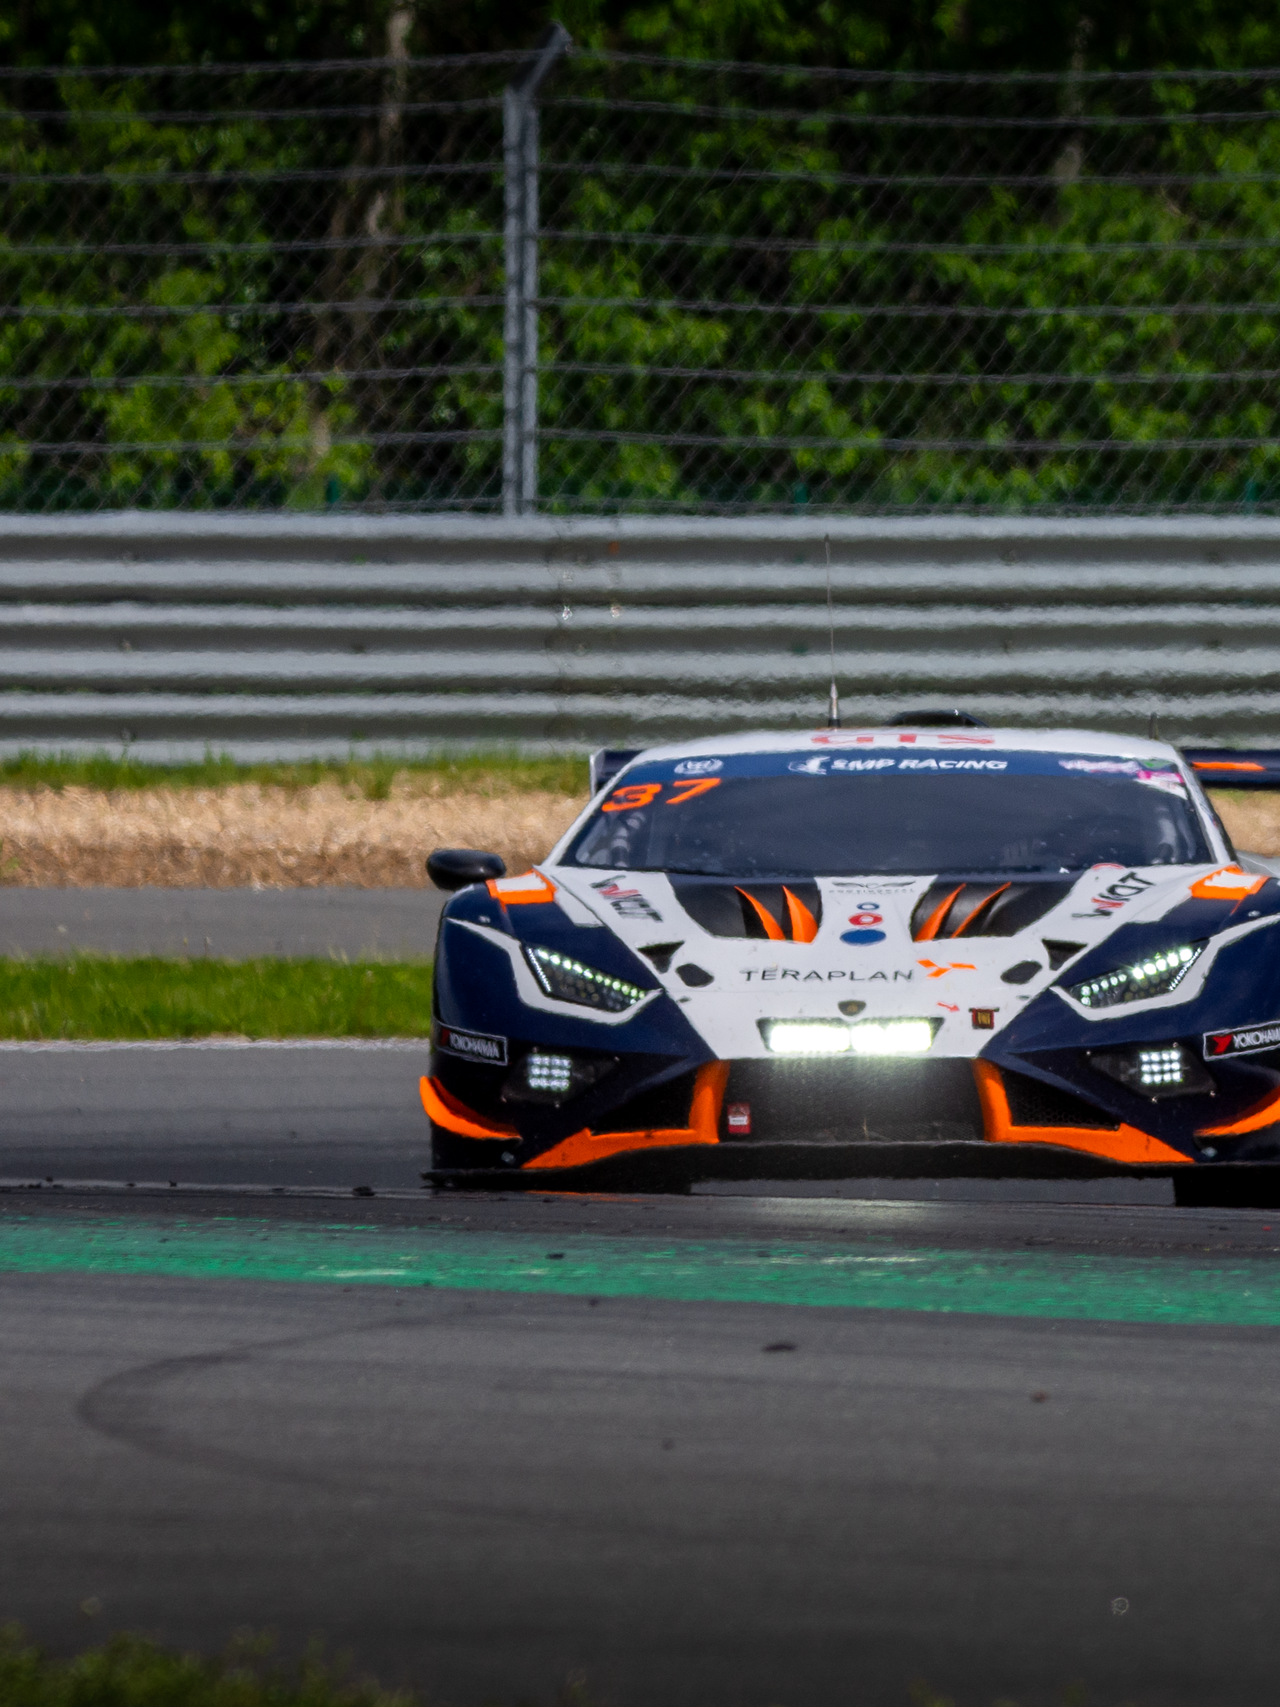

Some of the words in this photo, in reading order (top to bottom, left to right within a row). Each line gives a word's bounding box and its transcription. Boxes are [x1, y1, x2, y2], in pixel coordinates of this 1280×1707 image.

[831, 758, 895, 771] SMP
[898, 758, 1008, 770] RACING
[601, 777, 722, 812] 37
[739, 968, 914, 982] TERAPLAN
